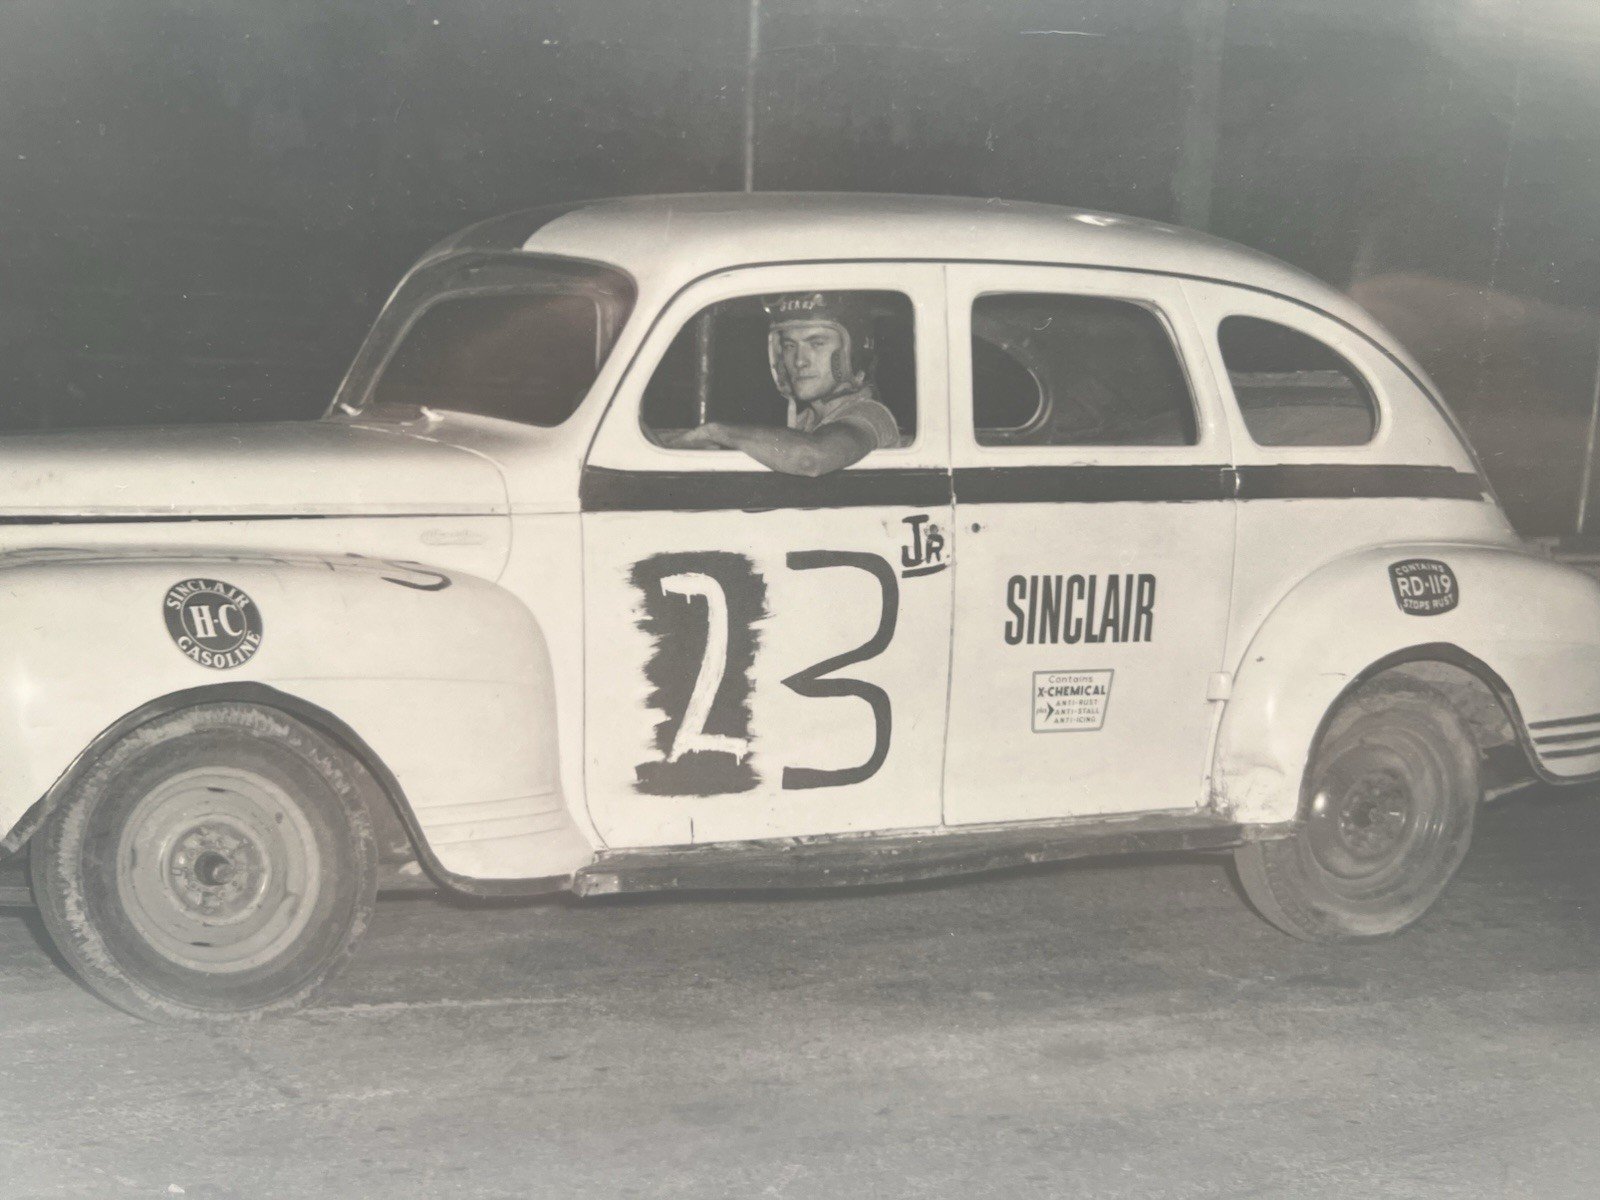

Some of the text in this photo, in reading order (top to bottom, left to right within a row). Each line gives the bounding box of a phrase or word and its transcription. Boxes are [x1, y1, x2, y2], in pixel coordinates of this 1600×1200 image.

[1395, 563, 1445, 575] CONTAINS
[166, 580, 250, 610] SINCLAIR
[1402, 593, 1453, 610] STOPS RUST
[1004, 574, 1156, 645] SINCLAIR
[177, 630, 261, 669] GASOLINE
[655, 550, 899, 790] 23
[1048, 675, 1094, 684] Contains
[1037, 685, 1106, 697] X-CHEMICAL
